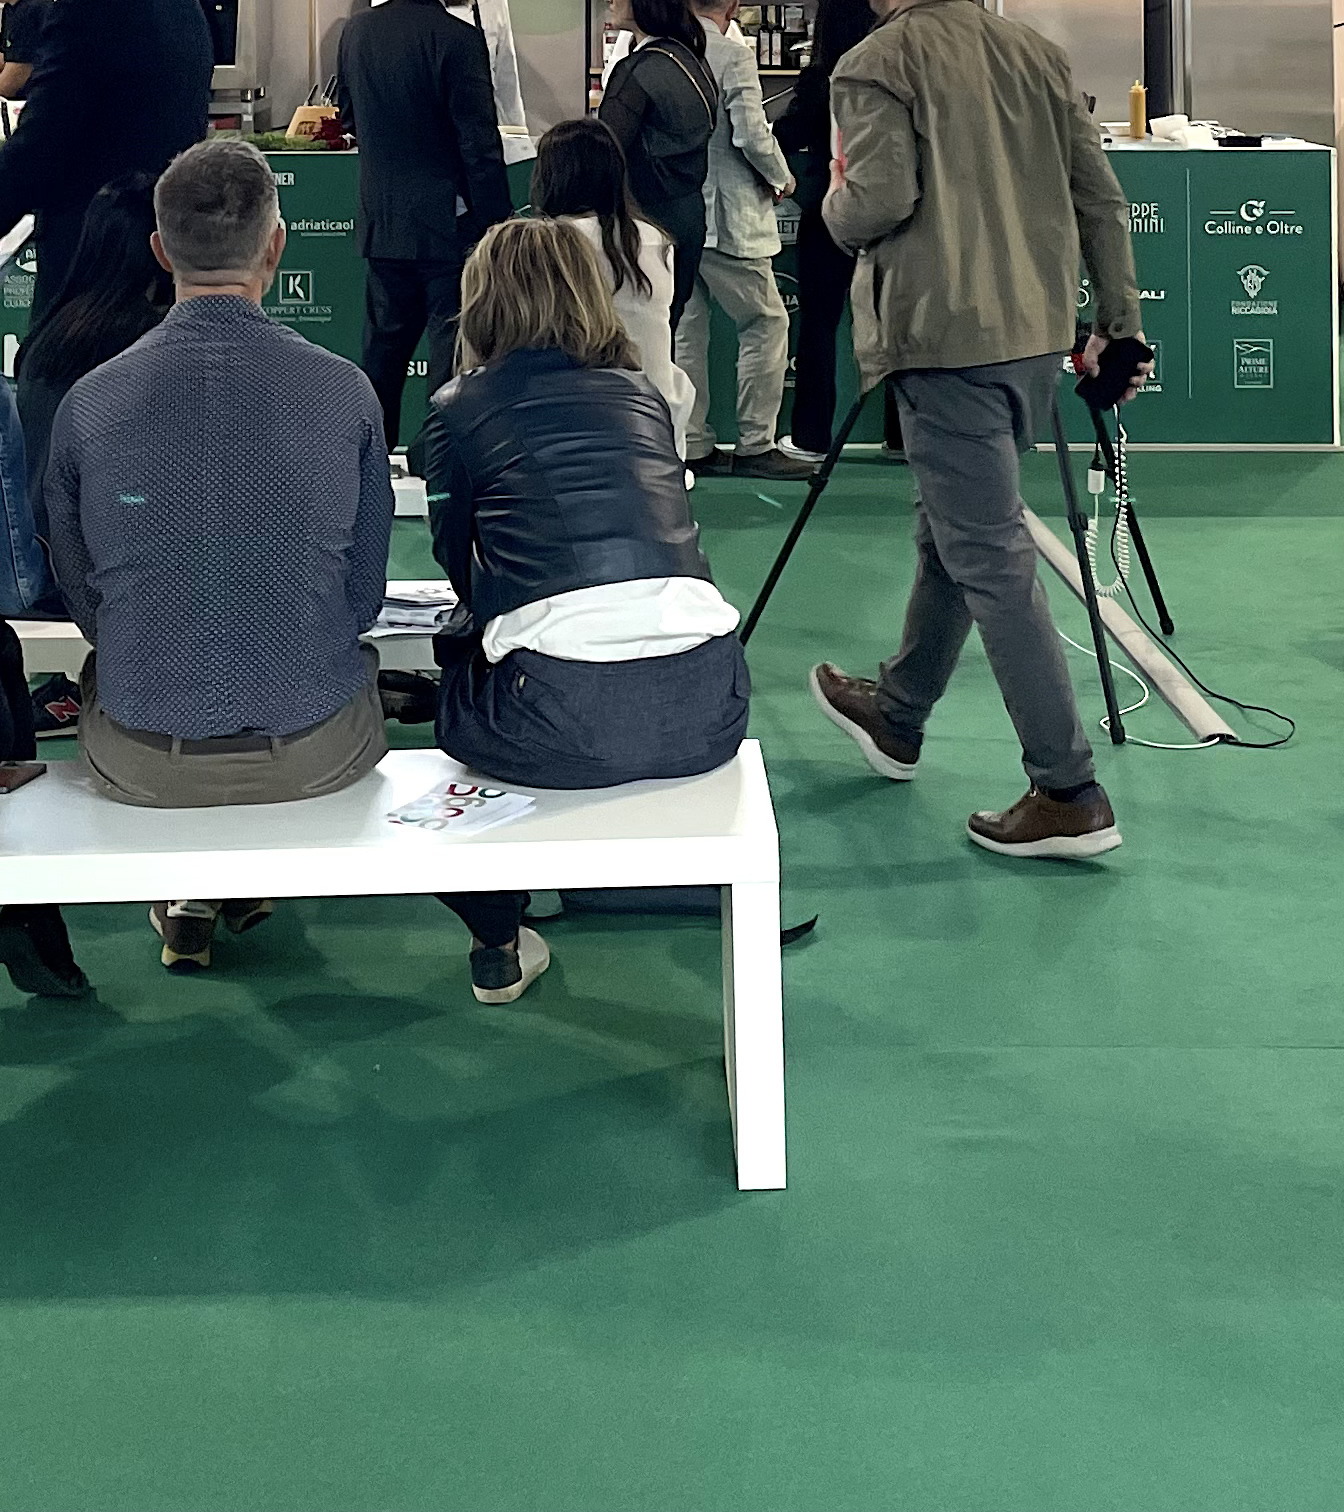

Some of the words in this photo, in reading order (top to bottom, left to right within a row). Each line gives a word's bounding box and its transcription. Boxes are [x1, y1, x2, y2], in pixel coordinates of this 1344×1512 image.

[1204, 220, 1252, 235] Colline
[1255, 223, 1264, 235] e
[1266, 220, 1304, 235] Oltre
